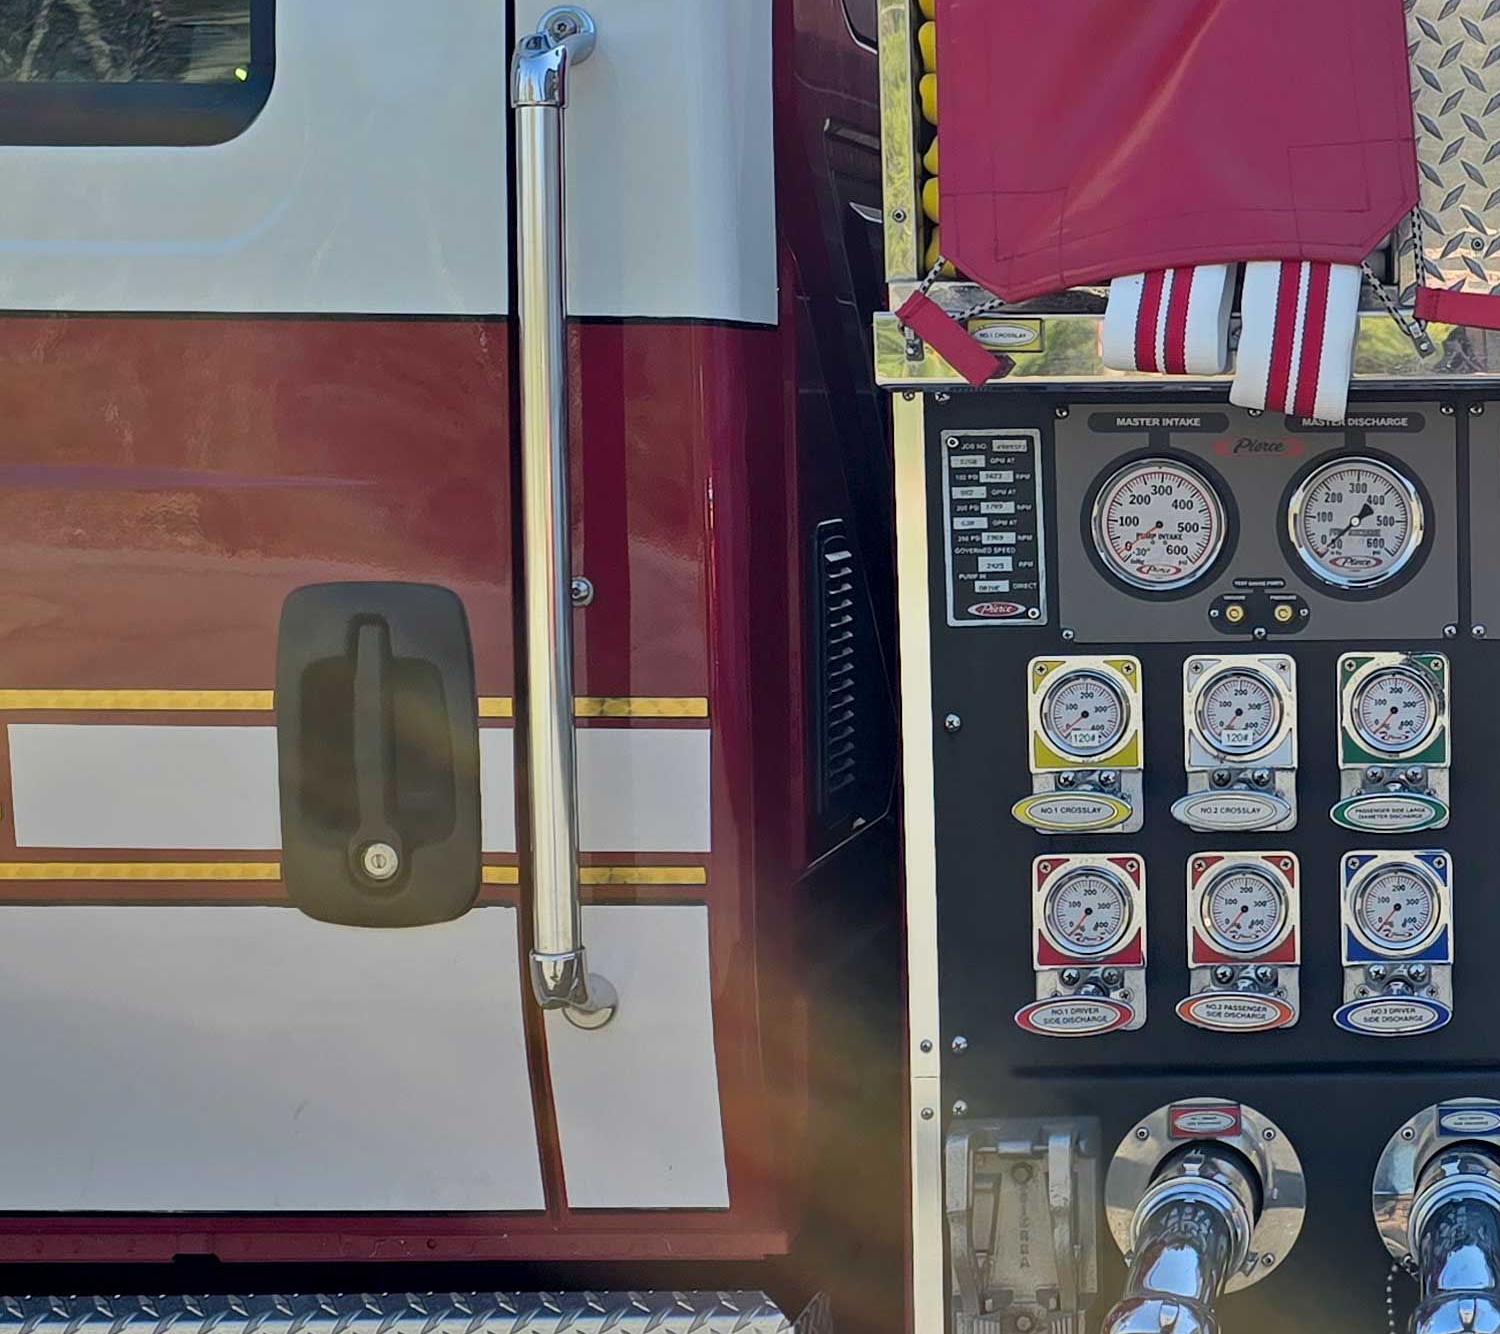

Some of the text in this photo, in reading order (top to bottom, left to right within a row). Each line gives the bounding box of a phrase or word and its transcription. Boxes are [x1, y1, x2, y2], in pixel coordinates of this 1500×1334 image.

[1117, 418, 1201, 427] MASTER INTAKE
[1349, 418, 1409, 427] DISCHARGE
[1233, 437, 1284, 454] Pierce
[1151, 485, 1173, 496] 300
[1349, 483, 1367, 494] 300
[1129, 494, 1151, 506] 200
[1325, 492, 1343, 503] 200
[1367, 494, 1385, 505] 400
[1172, 499, 1194, 510] 400
[1119, 516, 1140, 527] 100
[1317, 512, 1333, 522] 100
[1377, 517, 1395, 527] 500
[1178, 523, 1199, 533] 500
[1321, 535, 1327, 545] 0
[1367, 538, 1385, 549] 600
[1166, 545, 1188, 556] 600
[1342, 557, 1371, 568] Pierce
[981, 603, 1013, 615] Pierce
[1234, 689, 1248, 697] 200
[1389, 687, 1403, 695] 200
[1080, 692, 1094, 700] 200
[1065, 703, 1079, 711] 100
[1248, 703, 1262, 711] 300
[1374, 699, 1387, 707] 100
[1402, 701, 1416, 709] 300
[1094, 705, 1108, 714] 300
[1073, 734, 1096, 743] 120#
[1226, 734, 1249, 743] 120#
[1083, 889, 1098, 897] 200
[1240, 886, 1254, 894] 200
[1068, 901, 1081, 909] 100
[1097, 902, 1111, 910] 300
[1225, 898, 1238, 906] 100
[1253, 900, 1267, 908] 300
[1051, 1008, 1069, 1016] NO.1
[1224, 1012, 1266, 1020] DISCHARGE
[1043, 1016, 1108, 1025] SIDE DISCHARGE
[1382, 1015, 1423, 1023] DISCHARGE
